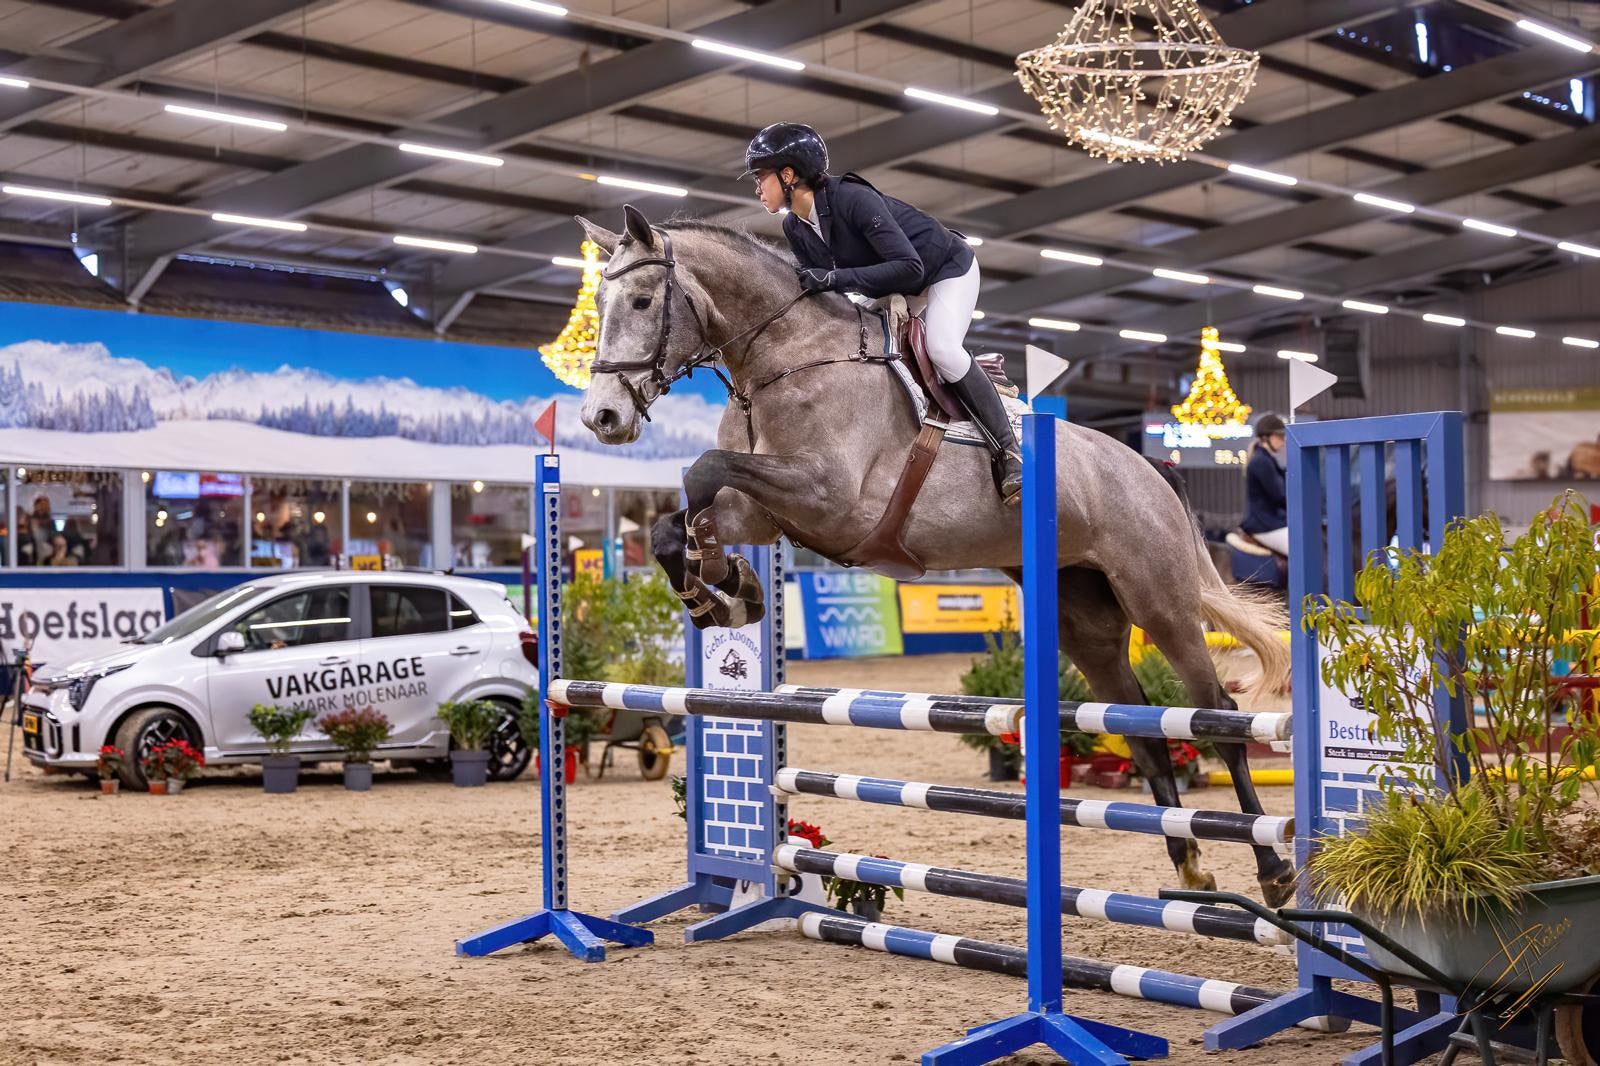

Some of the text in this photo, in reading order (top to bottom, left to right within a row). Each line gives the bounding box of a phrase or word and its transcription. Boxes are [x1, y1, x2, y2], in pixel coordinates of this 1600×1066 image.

[705, 634, 727, 659] Gebr.
[266, 656, 425, 699] VAKGARAGE
[293, 681, 429, 712] MARK MOLENAAR
